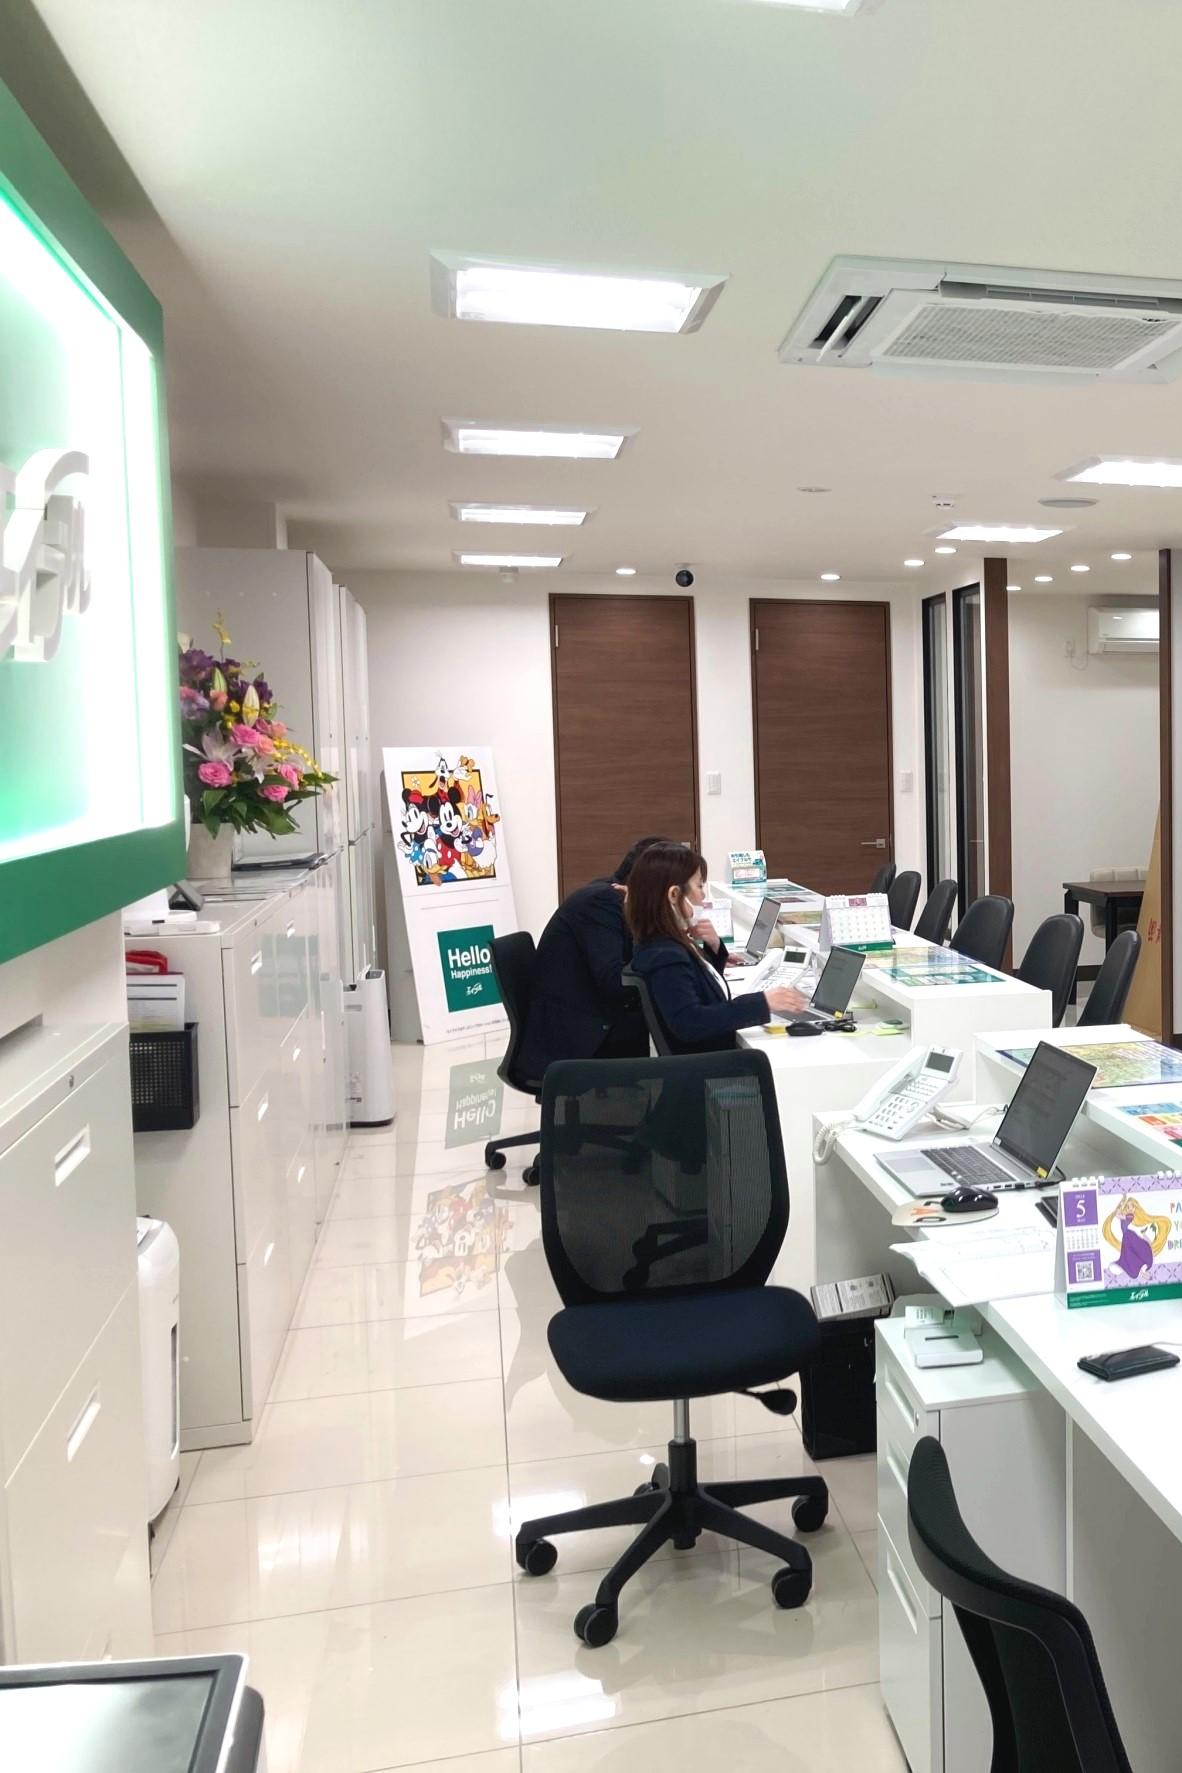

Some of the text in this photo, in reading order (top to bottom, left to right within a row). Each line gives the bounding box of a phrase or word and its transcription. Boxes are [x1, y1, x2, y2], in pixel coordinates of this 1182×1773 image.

[447, 945, 491, 969] Hello
[450, 963, 493, 980] Happiness!
[1076, 1199, 1086, 1219] 5
